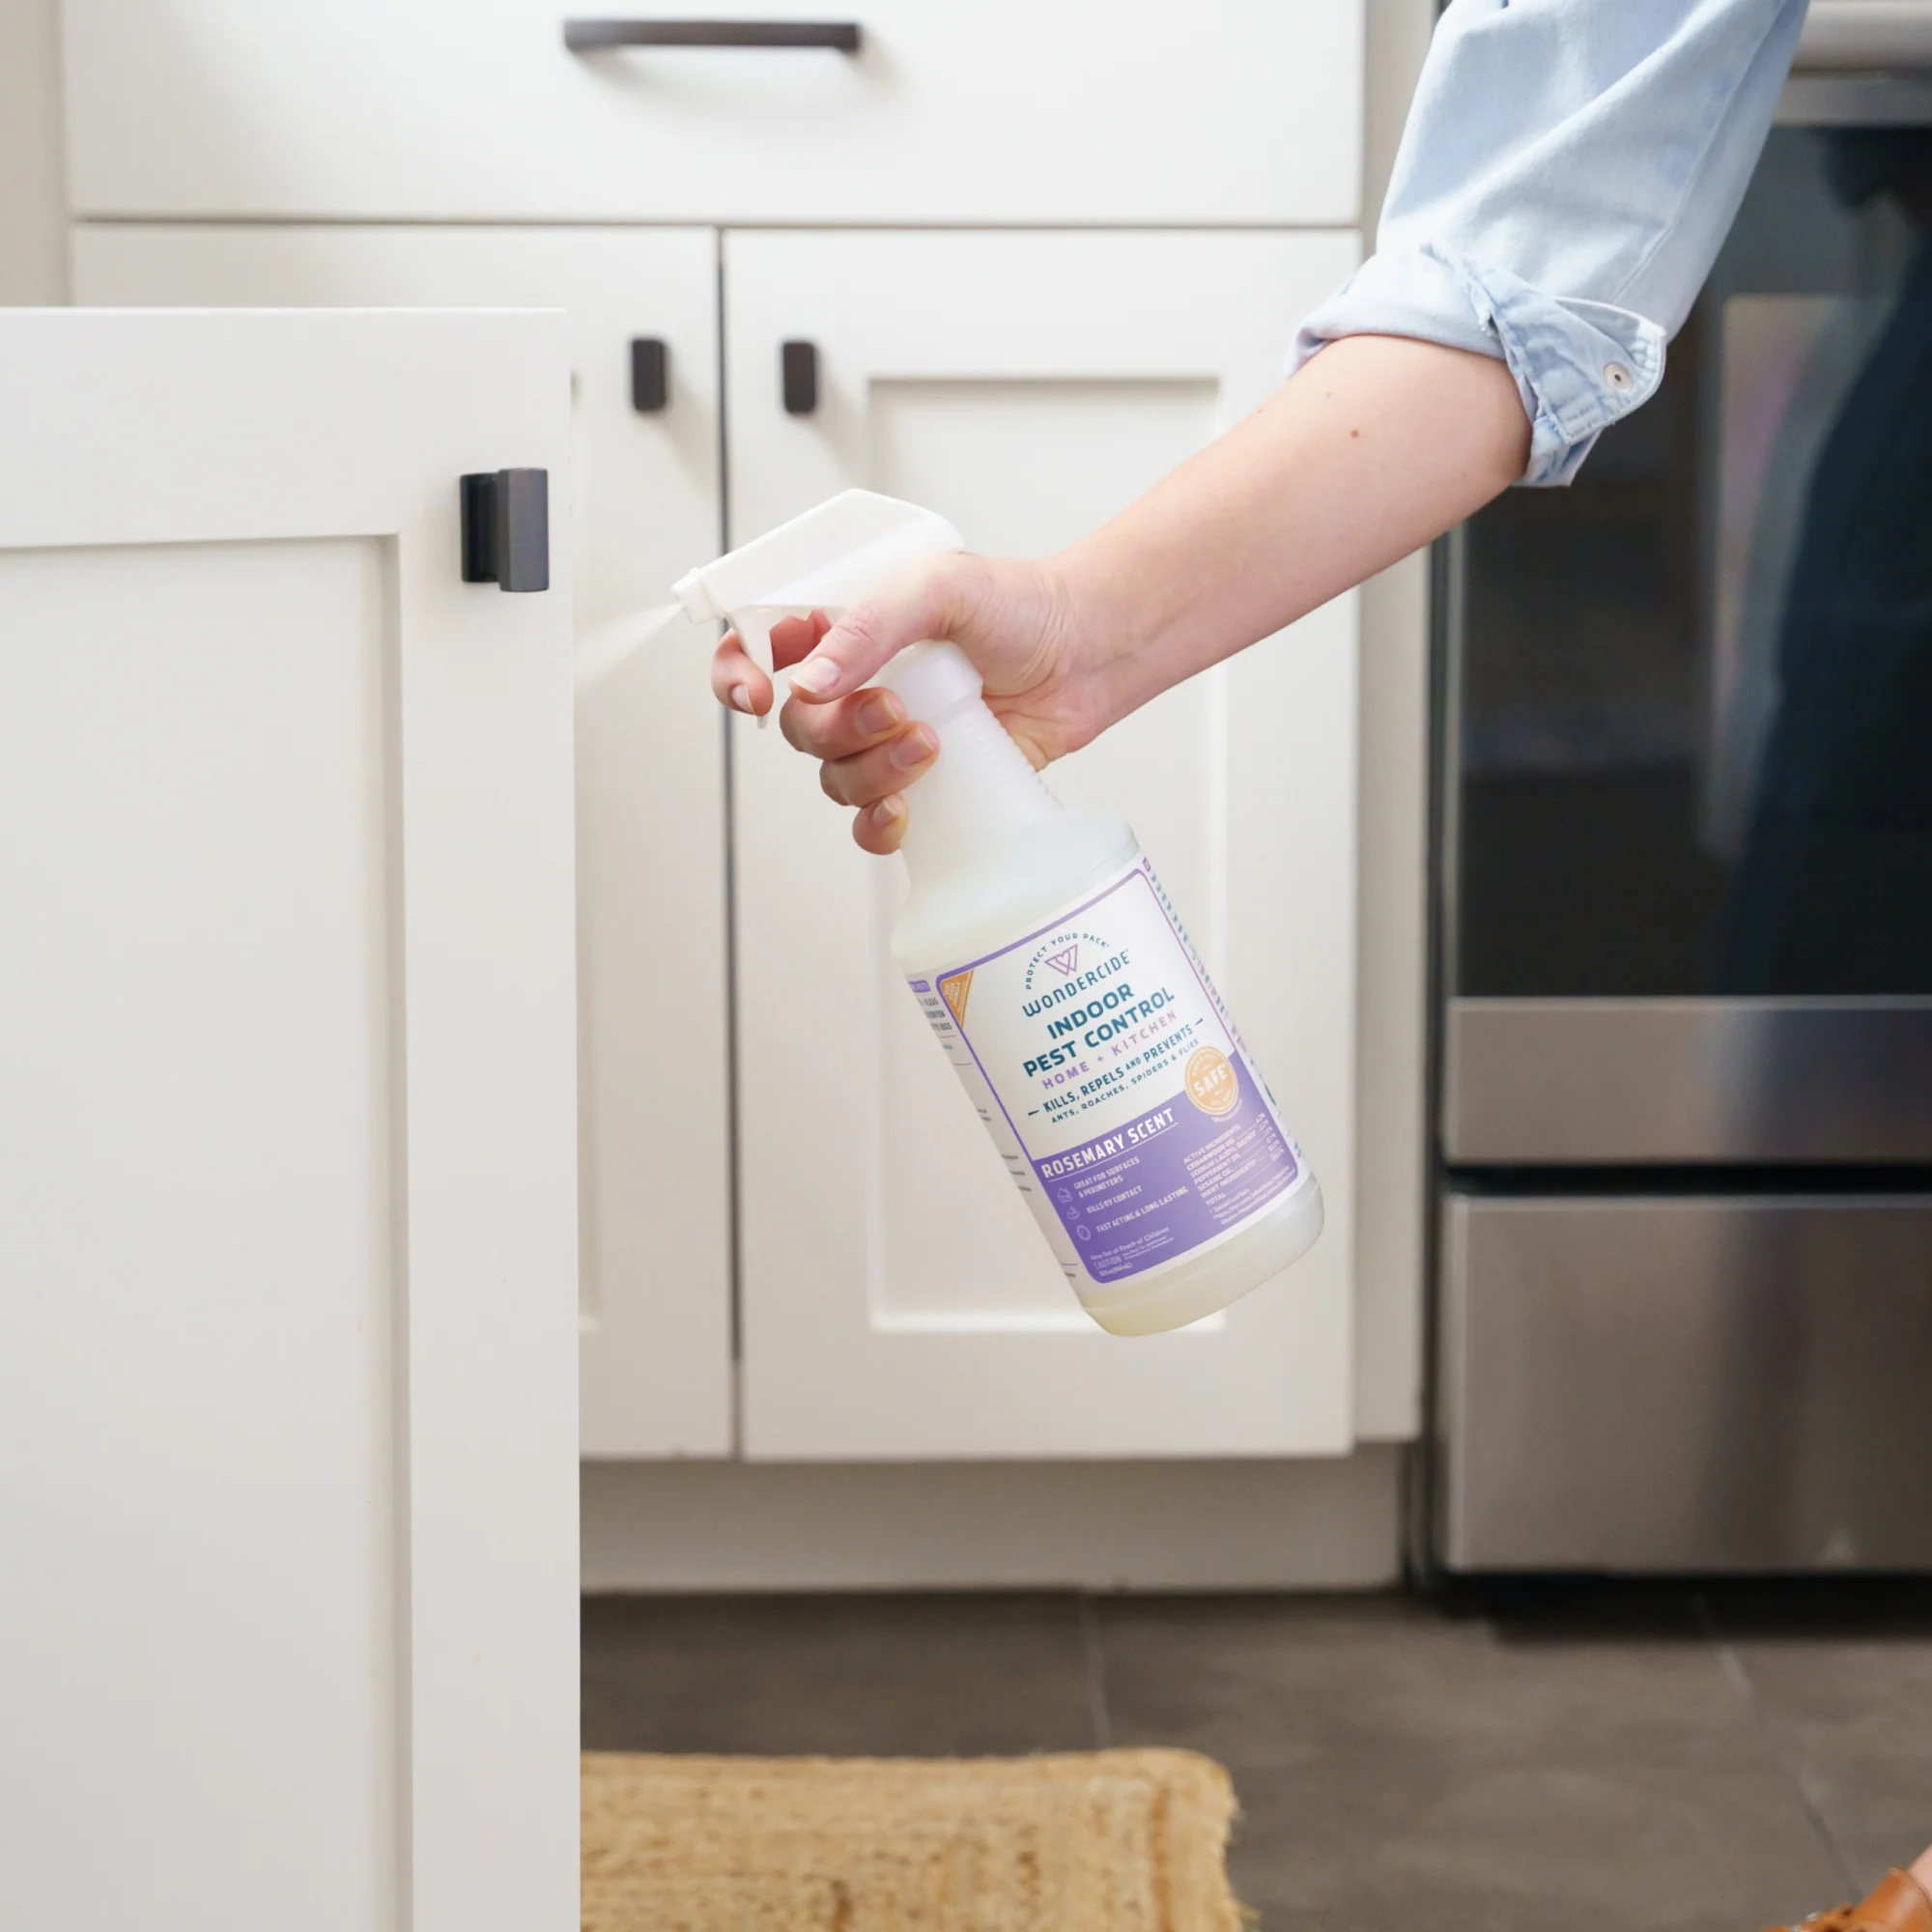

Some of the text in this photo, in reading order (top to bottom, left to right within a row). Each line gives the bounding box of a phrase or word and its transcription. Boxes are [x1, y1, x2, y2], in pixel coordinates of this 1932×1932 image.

[1022, 951, 1129, 1017] WONDERCIDE
[1026, 947, 1047, 989] PROTECT
[1051, 933, 1078, 946] YOUR
[1023, 1041, 1076, 1077] PEST
[1084, 987, 1175, 1048] CONTROL
[1047, 983, 1134, 1039] INDOOR
[1042, 1062, 1090, 1090] HOME
[1111, 1010, 1177, 1056] KITCHEN
[1043, 1024, 1193, 1112] KILLS, REPELS AND PREVENTS
[1051, 1109, 1078, 1123] ANTS,
[1081, 1084, 1129, 1109] ROACHES,
[1131, 1059, 1169, 1085] SPIDERS
[1179, 1039, 1199, 1057] FLIES
[1041, 1134, 1124, 1179] ROSEMARY
[1127, 1108, 1175, 1143] SCENT
[1073, 1156, 1140, 1189] GREAT FOR SURFACES
[1083, 1176, 1123, 1196] PERIMETERS
[1086, 1185, 1143, 1213] KILLS BY CONTACT
[1096, 1222, 1112, 1233] FAST
[1112, 1212, 1135, 1227] ACTING
[1141, 1202, 1160, 1214] LONG
[1159, 1186, 1189, 1206] LASTING
[1119, 1239, 1138, 1252] Reach
[1144, 1227, 1170, 1242] Children
